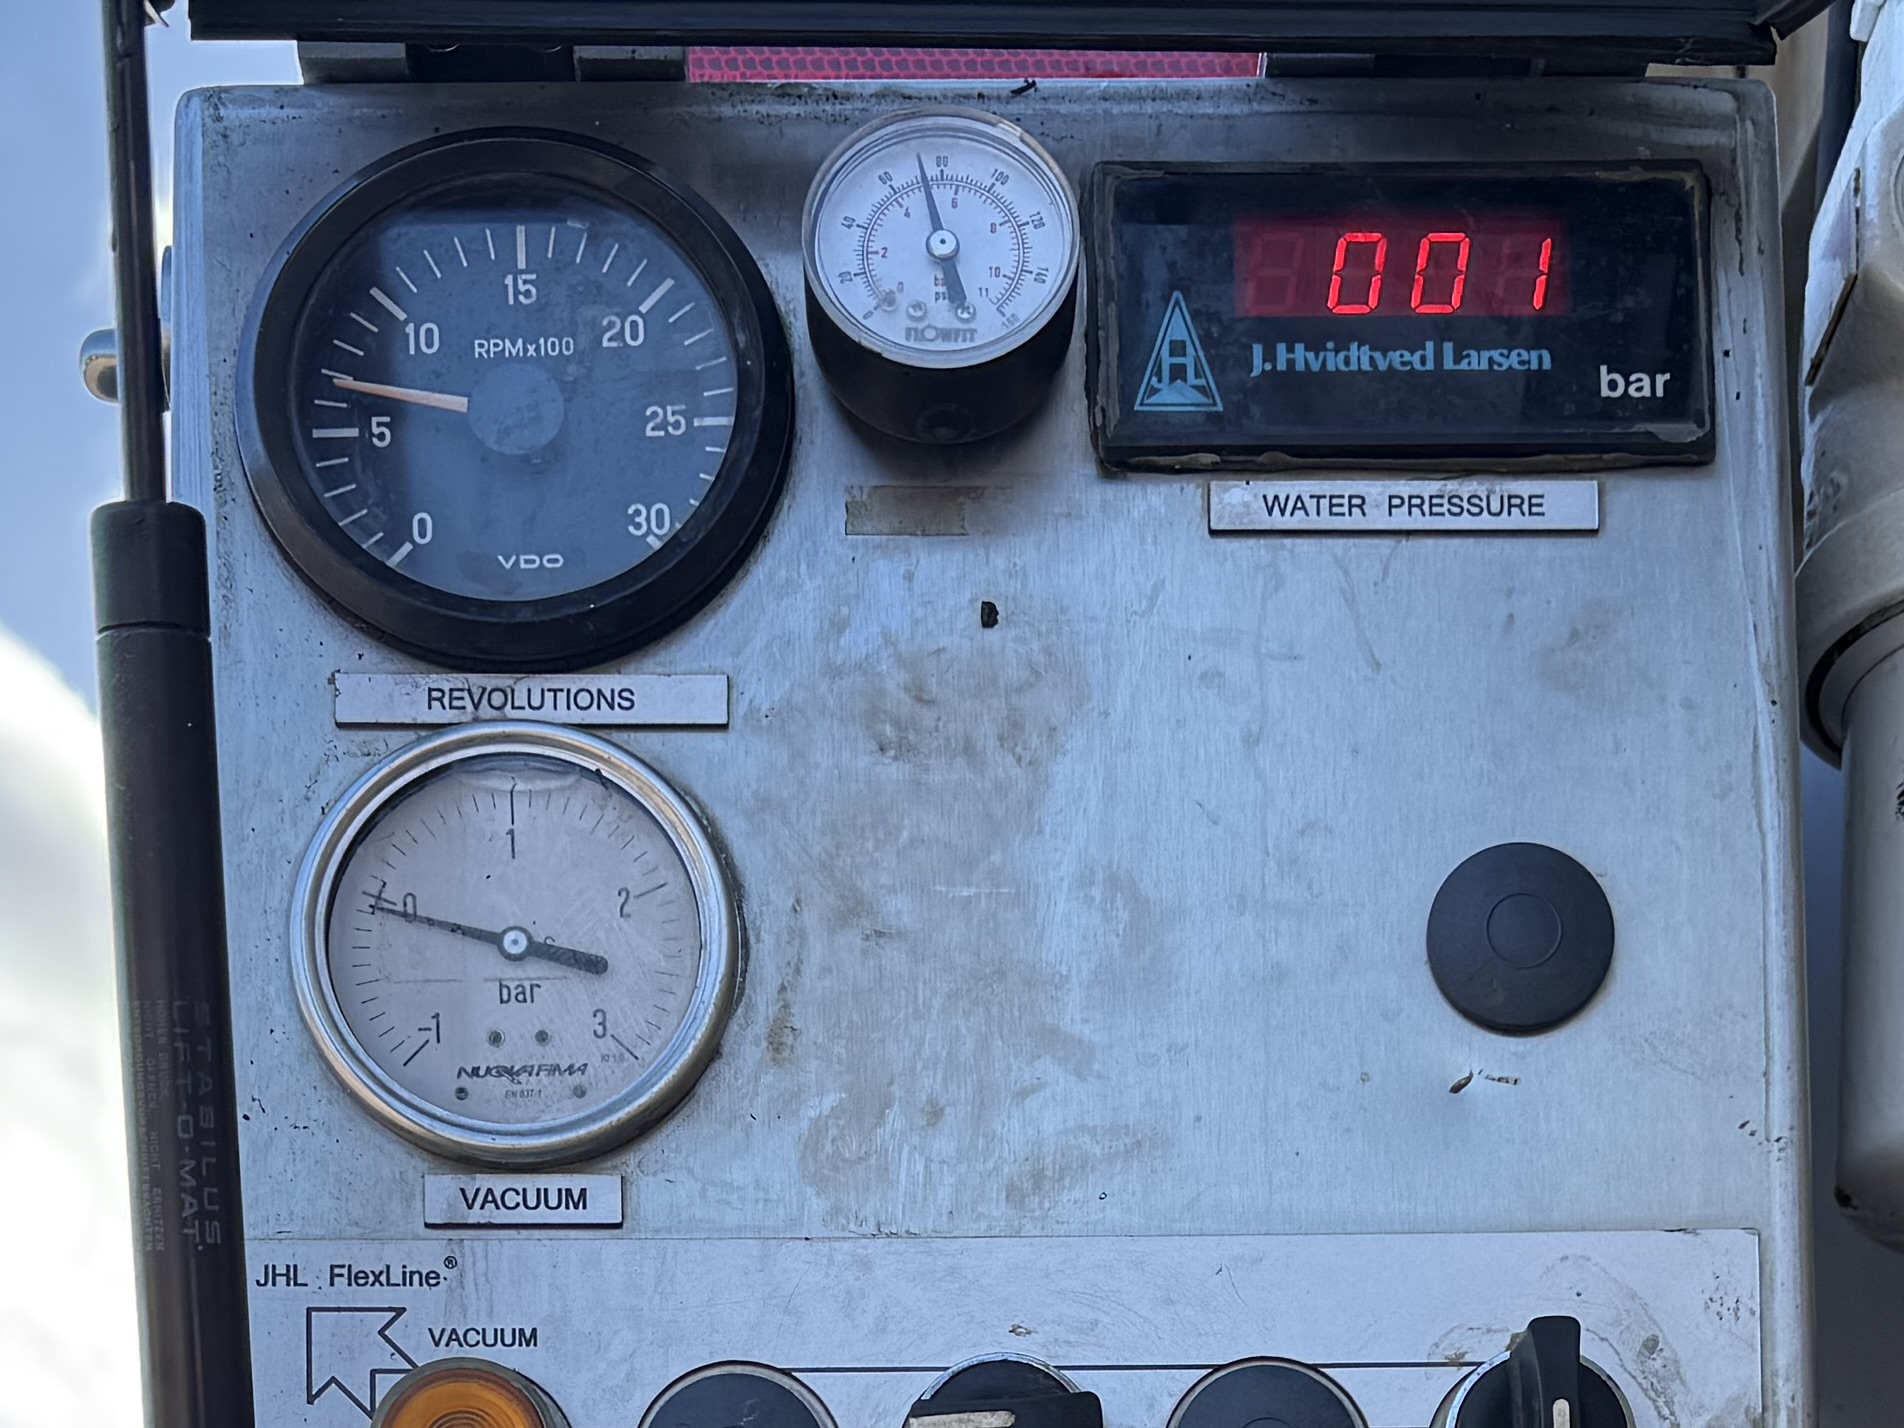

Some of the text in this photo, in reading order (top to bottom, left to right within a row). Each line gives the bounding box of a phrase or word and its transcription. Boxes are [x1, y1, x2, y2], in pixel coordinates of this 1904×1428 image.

[992, 168, 1010, 186] 100
[1028, 211, 1045, 230] 120
[881, 248, 888, 258] 2
[989, 267, 1001, 278] 10
[1034, 266, 1049, 284] 140
[1326, 231, 1554, 316] 001
[504, 273, 537, 306] 15
[978, 287, 989, 297] 11
[405, 322, 440, 356] 10
[601, 314, 645, 348] 20
[474, 337, 574, 359] RPMx100
[1442, 341, 1552, 371] Larsen
[1599, 364, 1671, 398] bar
[371, 416, 392, 448] 5
[645, 404, 686, 437] 25
[1262, 488, 1546, 518] WATER PRESSURE
[412, 512, 433, 545] 0
[627, 502, 671, 536] 30
[497, 553, 565, 570] VDO
[427, 684, 635, 712] REVOLUTIONS
[505, 828, 516, 860] 1
[402, 893, 418, 923] 0
[617, 887, 631, 918] 2
[498, 978, 542, 1005] bar
[417, 1013, 442, 1044] -1
[592, 1009, 607, 1039] 3
[196, 1002, 221, 1245] STABILUS
[458, 1186, 588, 1211] VACUUM
[256, 1265, 309, 1287] JHL
[427, 1327, 538, 1348] VACUUM
